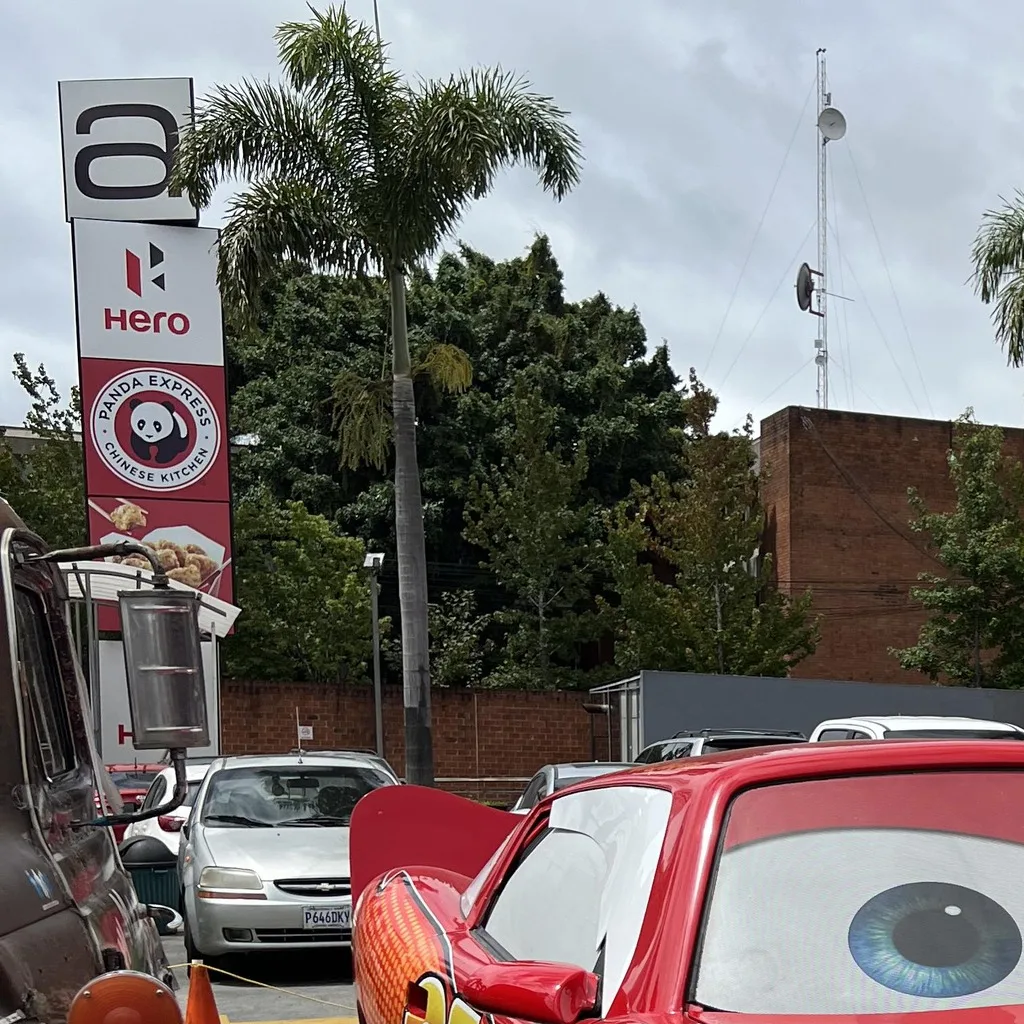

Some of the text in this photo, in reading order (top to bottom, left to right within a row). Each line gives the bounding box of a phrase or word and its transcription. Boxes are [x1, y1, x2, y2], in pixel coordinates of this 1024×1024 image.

[98, 374, 212, 427] PANDA EXPRESS
[104, 441, 209, 483] CHINESE KITCHEN
